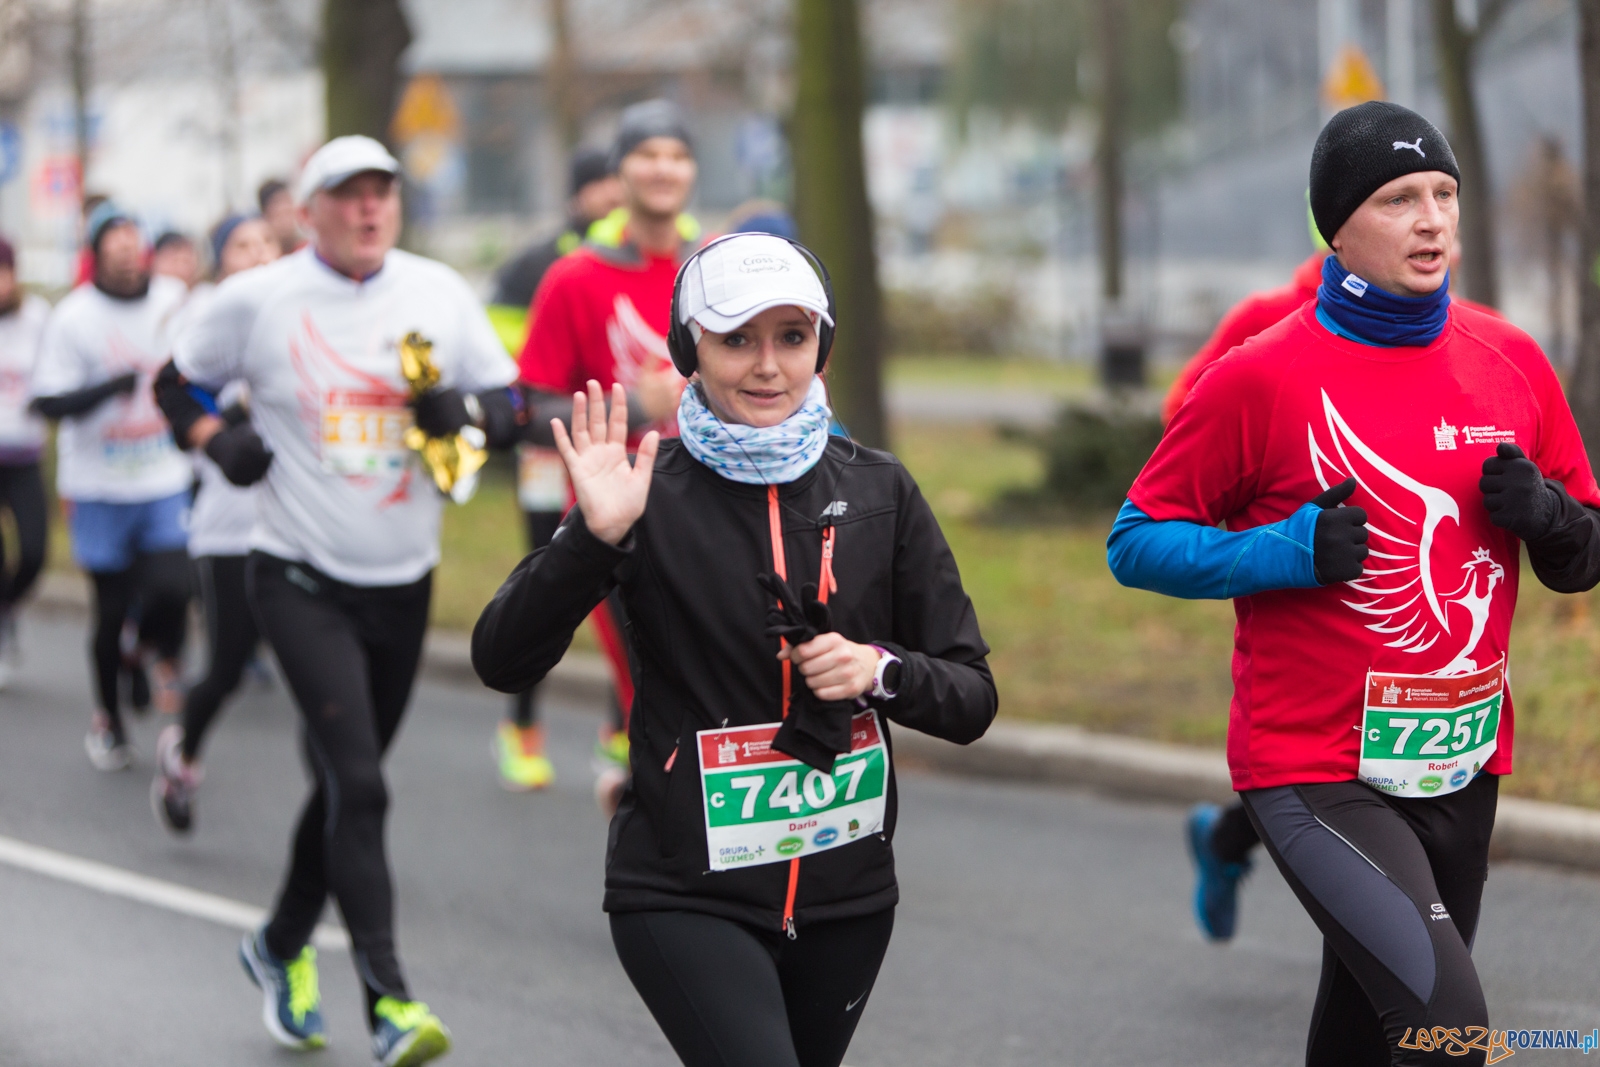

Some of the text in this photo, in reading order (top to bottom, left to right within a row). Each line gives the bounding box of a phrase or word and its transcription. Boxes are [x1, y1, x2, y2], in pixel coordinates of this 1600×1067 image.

[1462, 425, 1475, 444] 1
[1405, 687, 1412, 701] 1
[1458, 677, 1499, 699] RunPoland.org
[1388, 704, 1493, 756] 7257
[741, 741, 752, 758] 1
[1428, 760, 1459, 771] Robert
[1366, 776, 1394, 785] GRUPA
[730, 757, 868, 820] 7407
[789, 820, 818, 832] Daria
[719, 846, 749, 856] GRUPA
[720, 853, 755, 864] LUXMED
